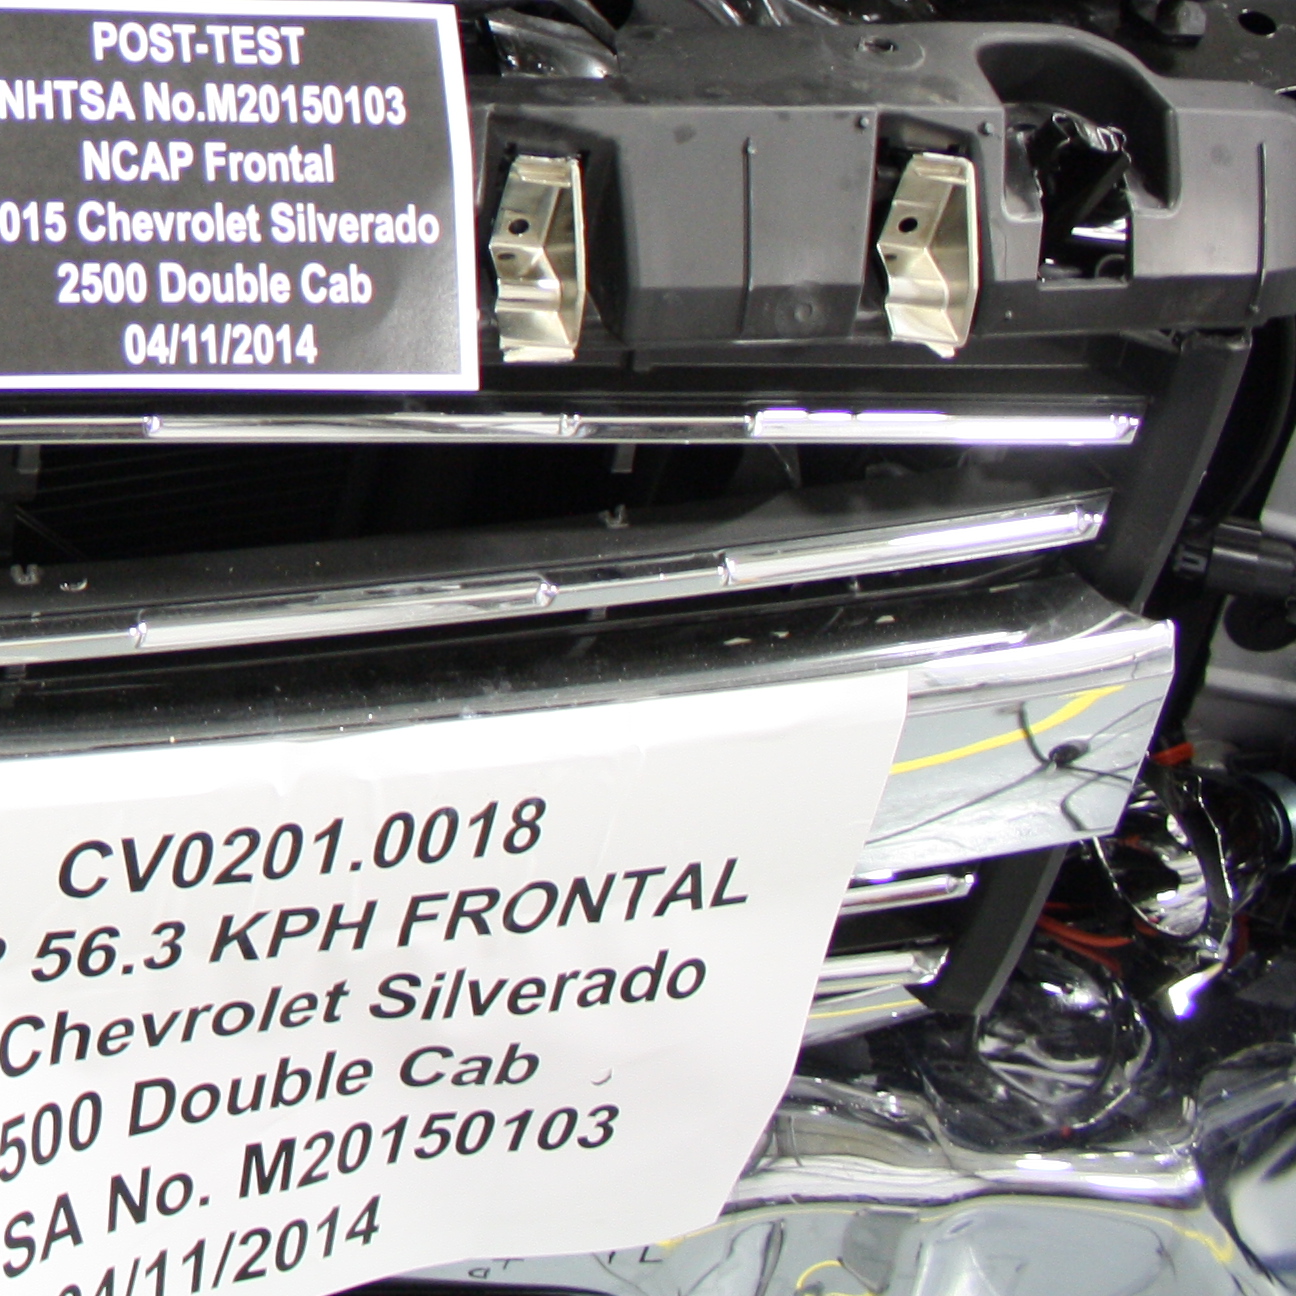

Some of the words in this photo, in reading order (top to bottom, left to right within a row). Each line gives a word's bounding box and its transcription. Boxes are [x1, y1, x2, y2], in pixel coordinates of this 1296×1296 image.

[92, 21, 305, 66] POST-TEST
[142, 81, 407, 126] No.M20150103
[82, 140, 194, 182] NCAP
[203, 141, 335, 184] Frontal
[77, 200, 264, 244] Chevrolet
[269, 201, 440, 246] Silverado
[56, 261, 148, 304] 2500
[158, 261, 292, 304] Double
[300, 261, 374, 305] Cab
[123, 321, 319, 366] 04/11/2014
[58, 798, 546, 899] CV0201.0018
[31, 920, 186, 982] 56.3
[210, 901, 377, 964] KPH
[398, 858, 748, 947] FRONTAL
[368, 950, 706, 1020] Silverado
[128, 1050, 373, 1136] Double
[398, 1043, 540, 1087] Cab
[108, 1166, 212, 1232] No.
[238, 1104, 620, 1198] M20150103
[59, 1194, 380, 1296] 4/11/2014
